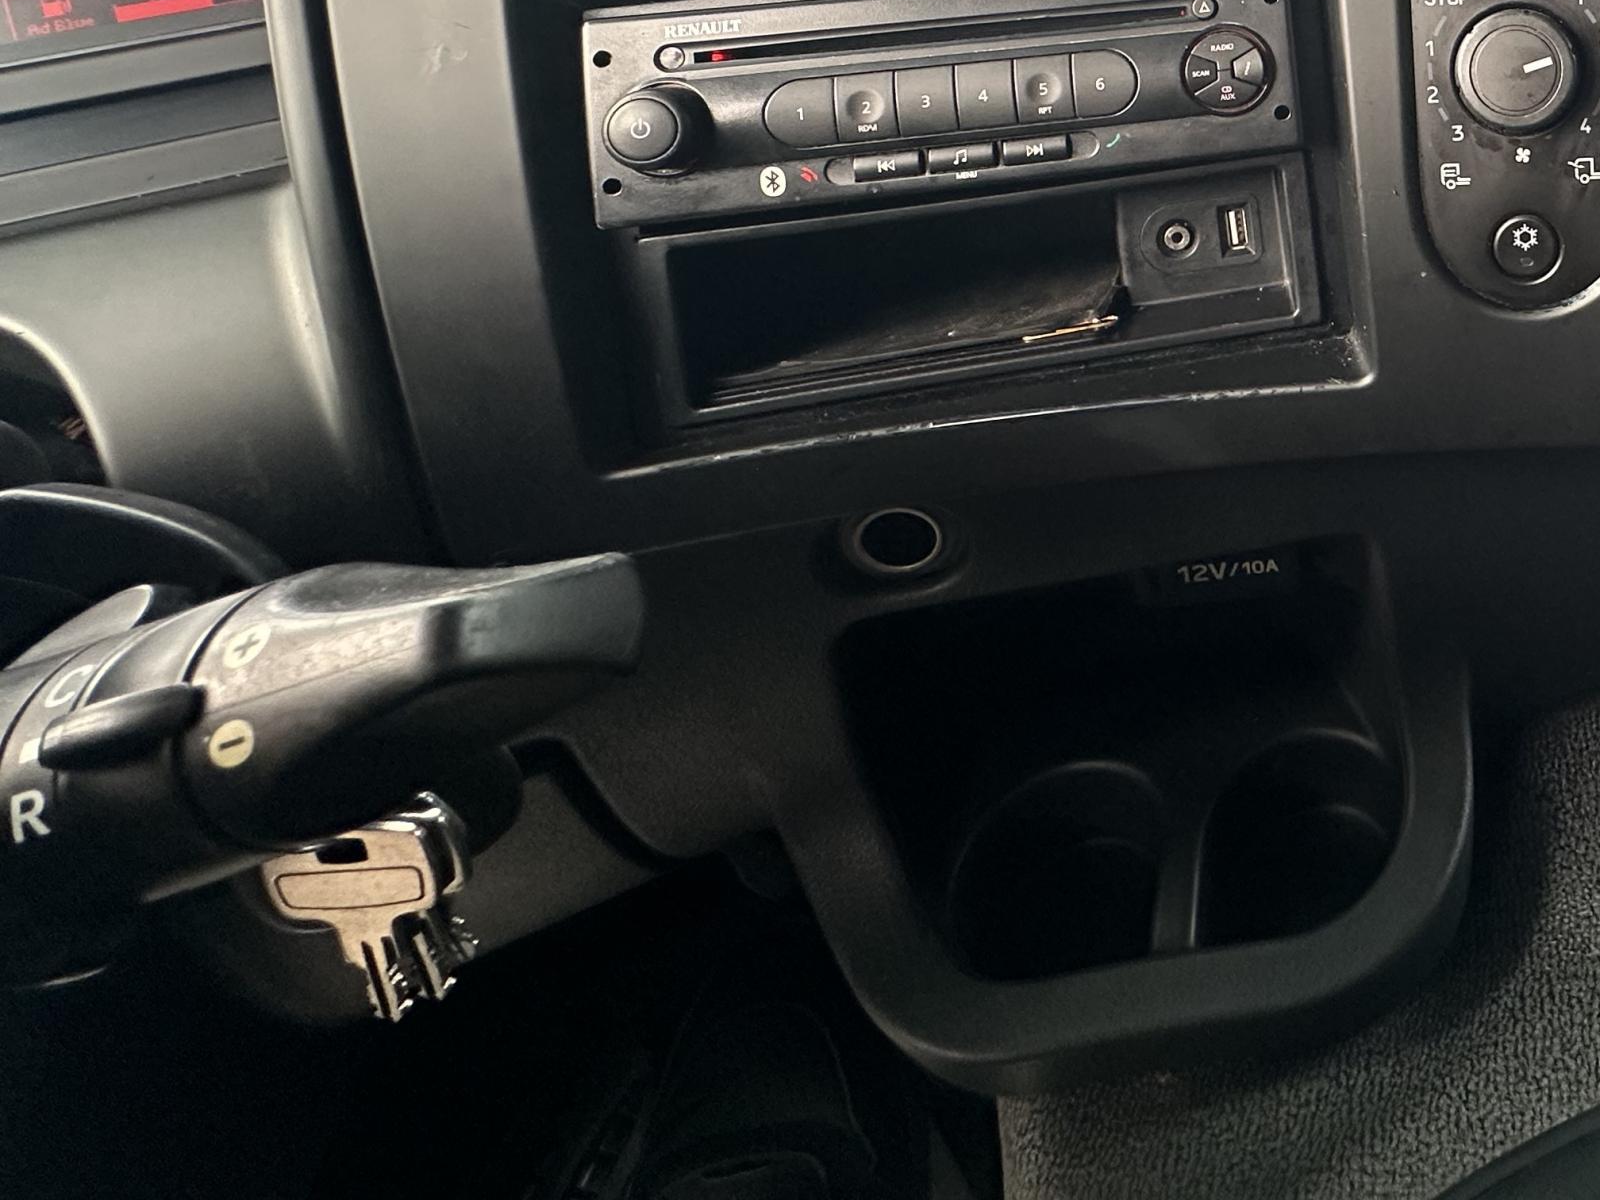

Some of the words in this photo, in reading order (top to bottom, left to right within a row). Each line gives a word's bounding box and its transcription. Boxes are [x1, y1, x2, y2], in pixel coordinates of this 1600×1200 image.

[664, 19, 742, 39] RENAULT
[1210, 42, 1234, 52] RADIO
[1425, 40, 1434, 57] 1
[1191, 69, 1211, 78] SCAN
[1220, 92, 1236, 101] AUX
[1221, 85, 1232, 93] CD
[1427, 86, 1440, 104] 2
[796, 107, 805, 121] 1
[862, 101, 872, 115] 2
[921, 95, 931, 109] 3
[978, 88, 989, 102] 4
[1039, 82, 1049, 96] 5
[1095, 77, 1106, 91] 6
[1451, 124, 1465, 142] 3
[1580, 117, 1592, 134] 4
[956, 169, 978, 180] MENU
[1177, 559, 1280, 584] 12V/10A
[45, 664, 96, 709] C
[10, 789, 51, 844] R
